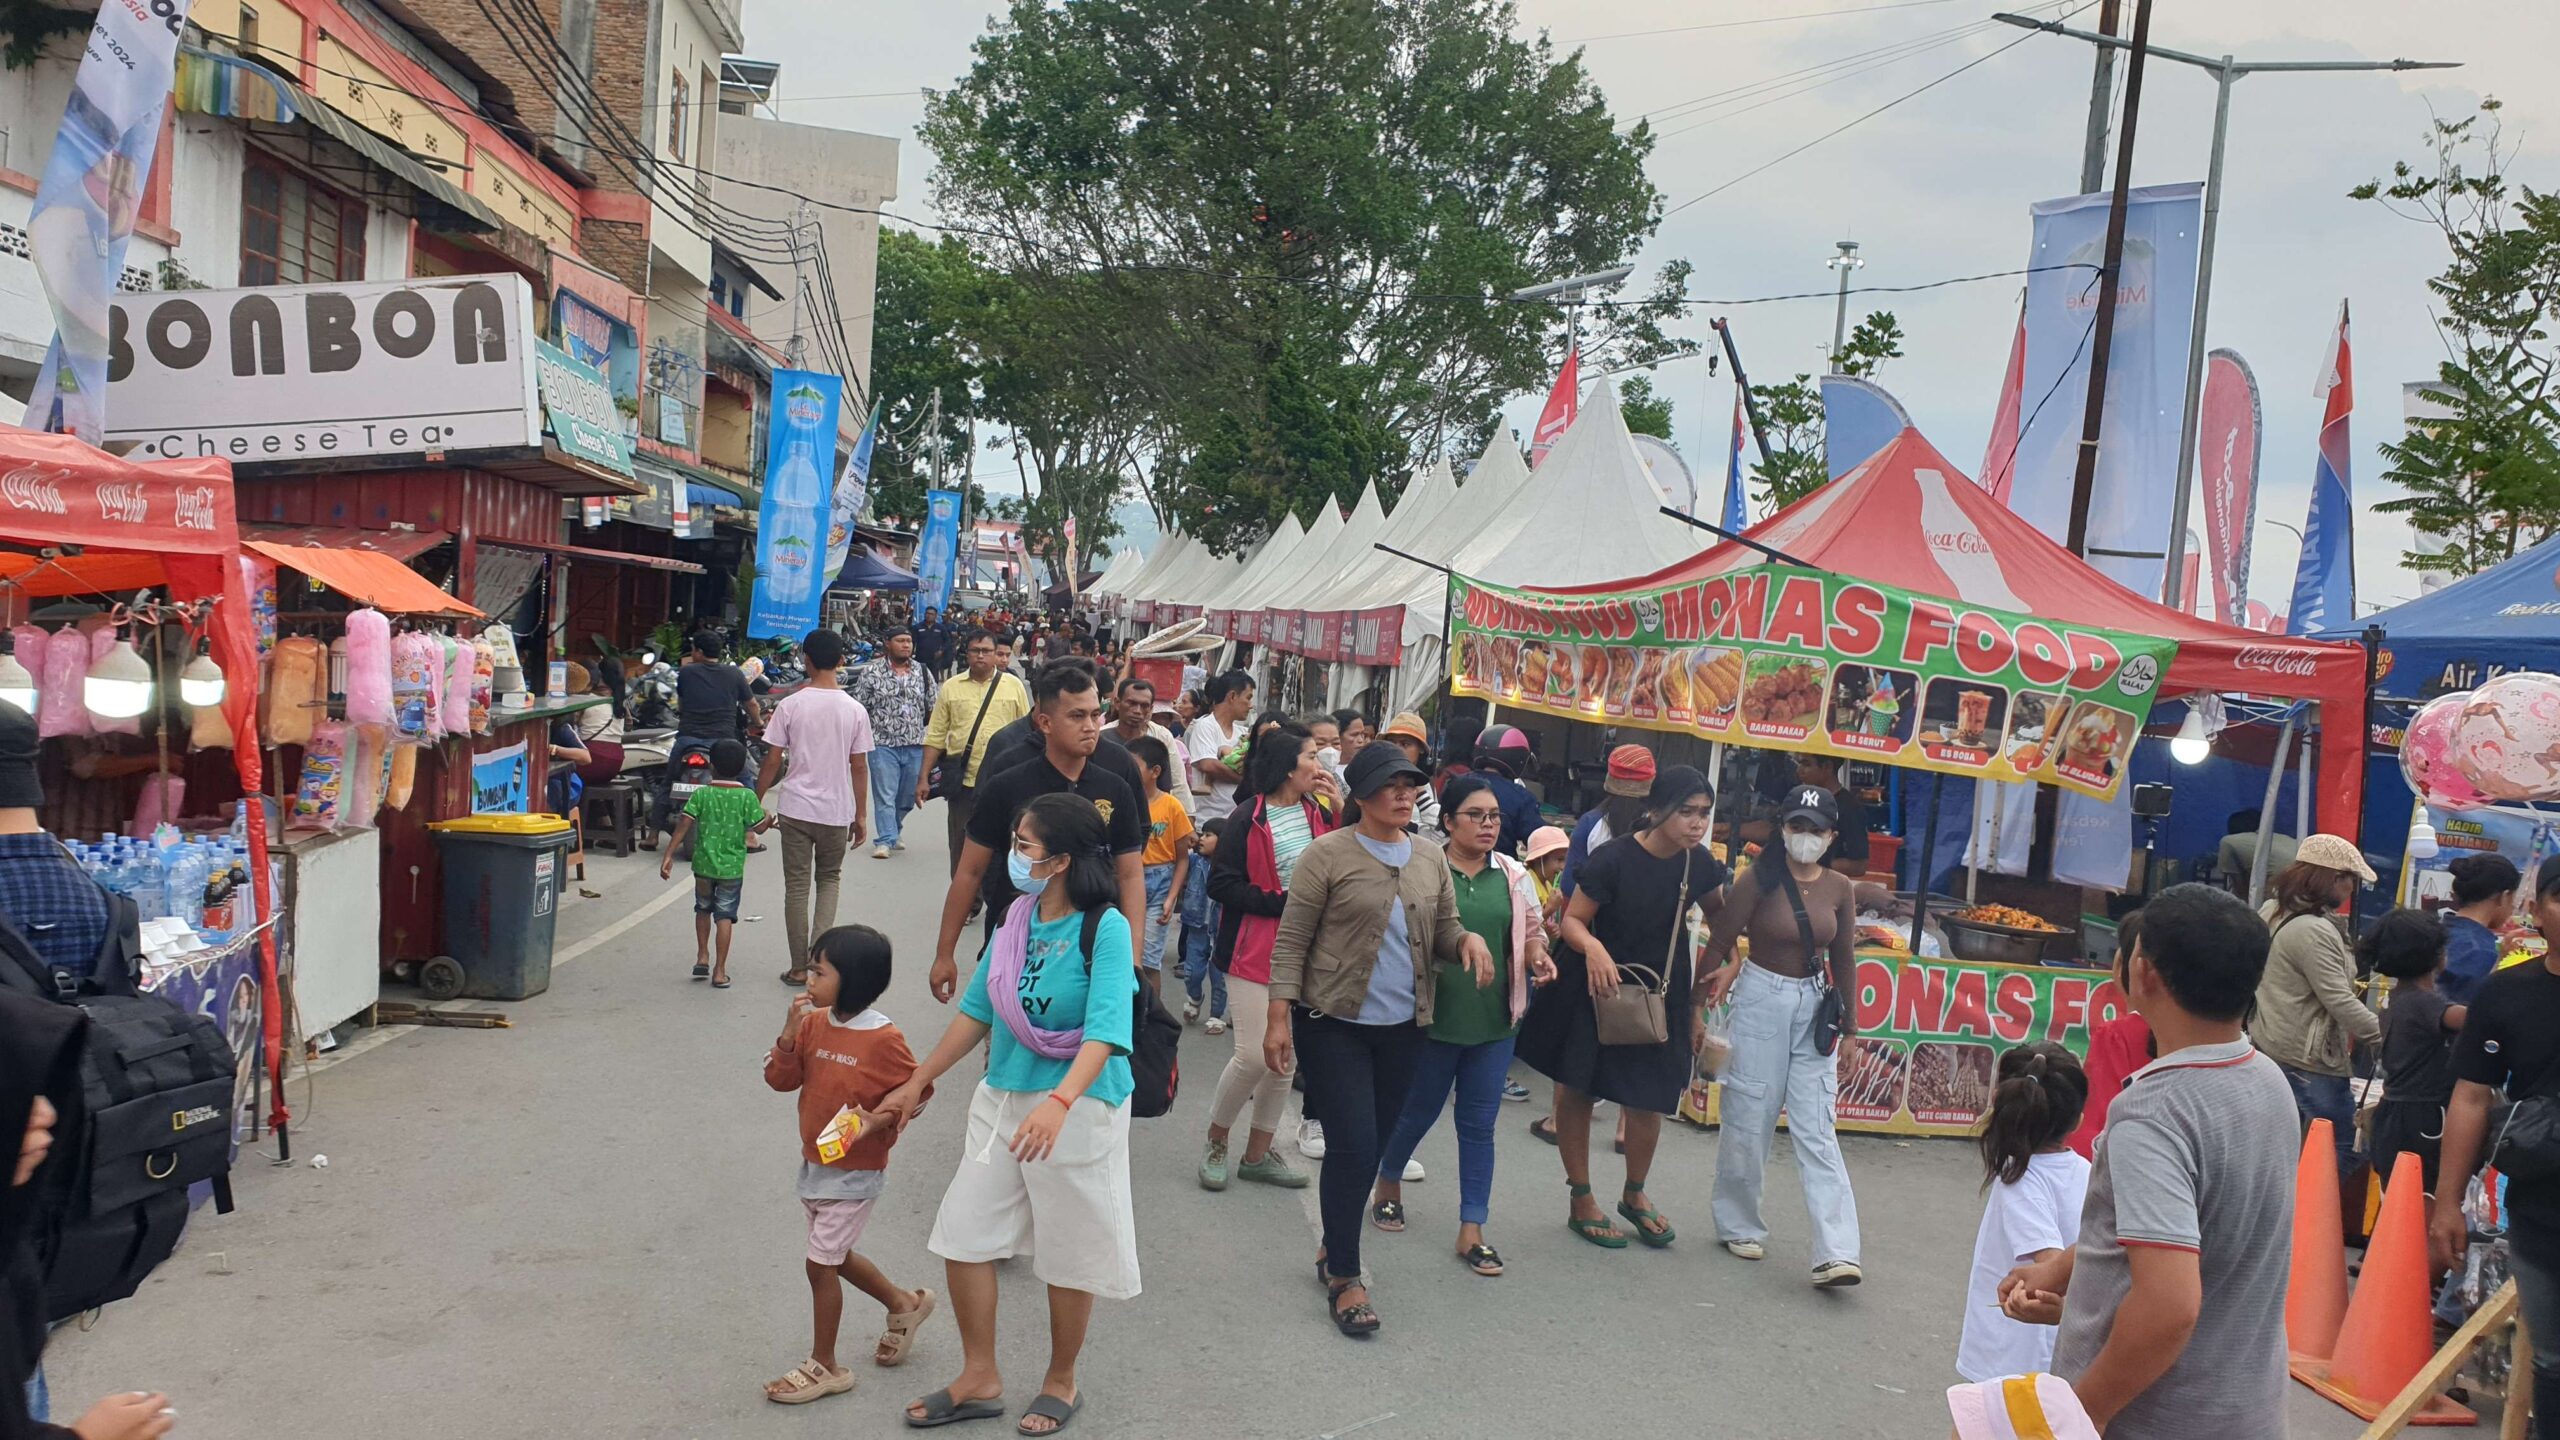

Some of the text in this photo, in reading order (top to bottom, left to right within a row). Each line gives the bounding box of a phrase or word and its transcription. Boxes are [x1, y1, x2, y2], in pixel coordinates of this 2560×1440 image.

[107, 38, 136, 71] 2024
[159, 424, 442, 459] Cheese Tea
[1660, 573, 2122, 692] MONAS FOOD
[2440, 663, 2477, 689] Air
[1749, 722, 1805, 737] BAKSO BAKAR
[1845, 734, 1886, 748] ES SERUT
[1953, 750, 1976, 762] BOBA
[2446, 819, 2482, 834] HADIR
[1021, 996, 1053, 1015] RY
[1855, 959, 2128, 1044] ONAS FO
[836, 1053, 858, 1067] WASH
